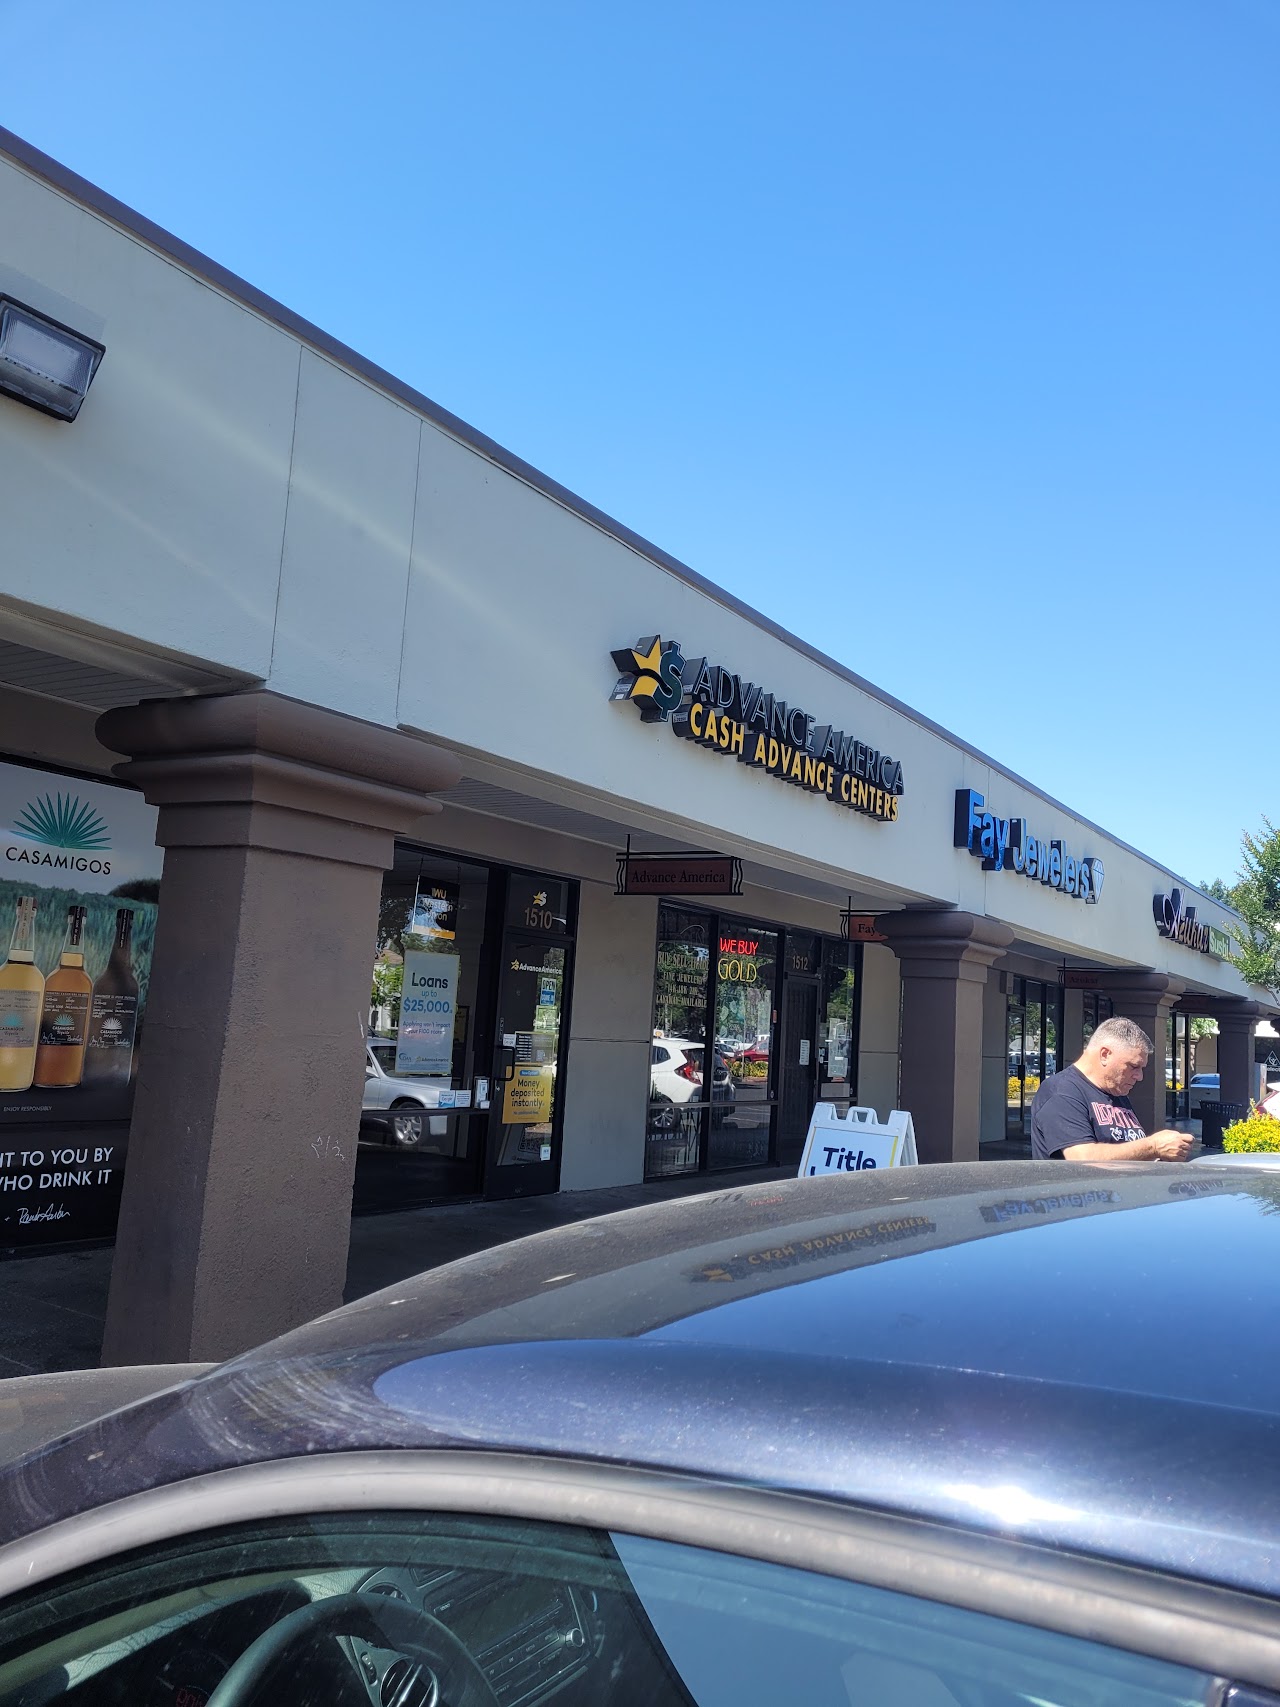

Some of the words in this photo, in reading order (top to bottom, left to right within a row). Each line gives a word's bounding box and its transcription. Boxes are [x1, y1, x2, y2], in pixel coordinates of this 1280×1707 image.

[693, 656, 817, 753] ADVANCE
[821, 724, 905, 794] AMERICA
[689, 702, 745, 755] CASH
[753, 732, 835, 794] ADVANCE
[840, 772, 900, 823] CENTERS
[967, 788, 1010, 872] Fay
[1012, 817, 1090, 900] Jewelers
[5, 846, 112, 876] CASAMIGOS
[631, 870, 677, 884] Advance
[679, 869, 726, 884] America
[524, 907, 554, 930] 1510
[719, 937, 737, 953] WE
[737, 940, 759, 956] BUY
[1209, 930, 1230, 959] Sushi
[717, 958, 757, 983] GOLD
[792, 954, 809, 971] 1512
[411, 972, 449, 989] Loans
[421, 991, 430, 999] up
[431, 990, 438, 998] to
[510, 1088, 545, 1099] deposited
[20, 1150, 44, 1167] TO
[51, 1148, 88, 1165] YOU
[93, 1146, 114, 1162] BY
[823, 1146, 877, 1172] Title
[39, 1170, 92, 1189] DRINK
[97, 1169, 112, 1185] IT
